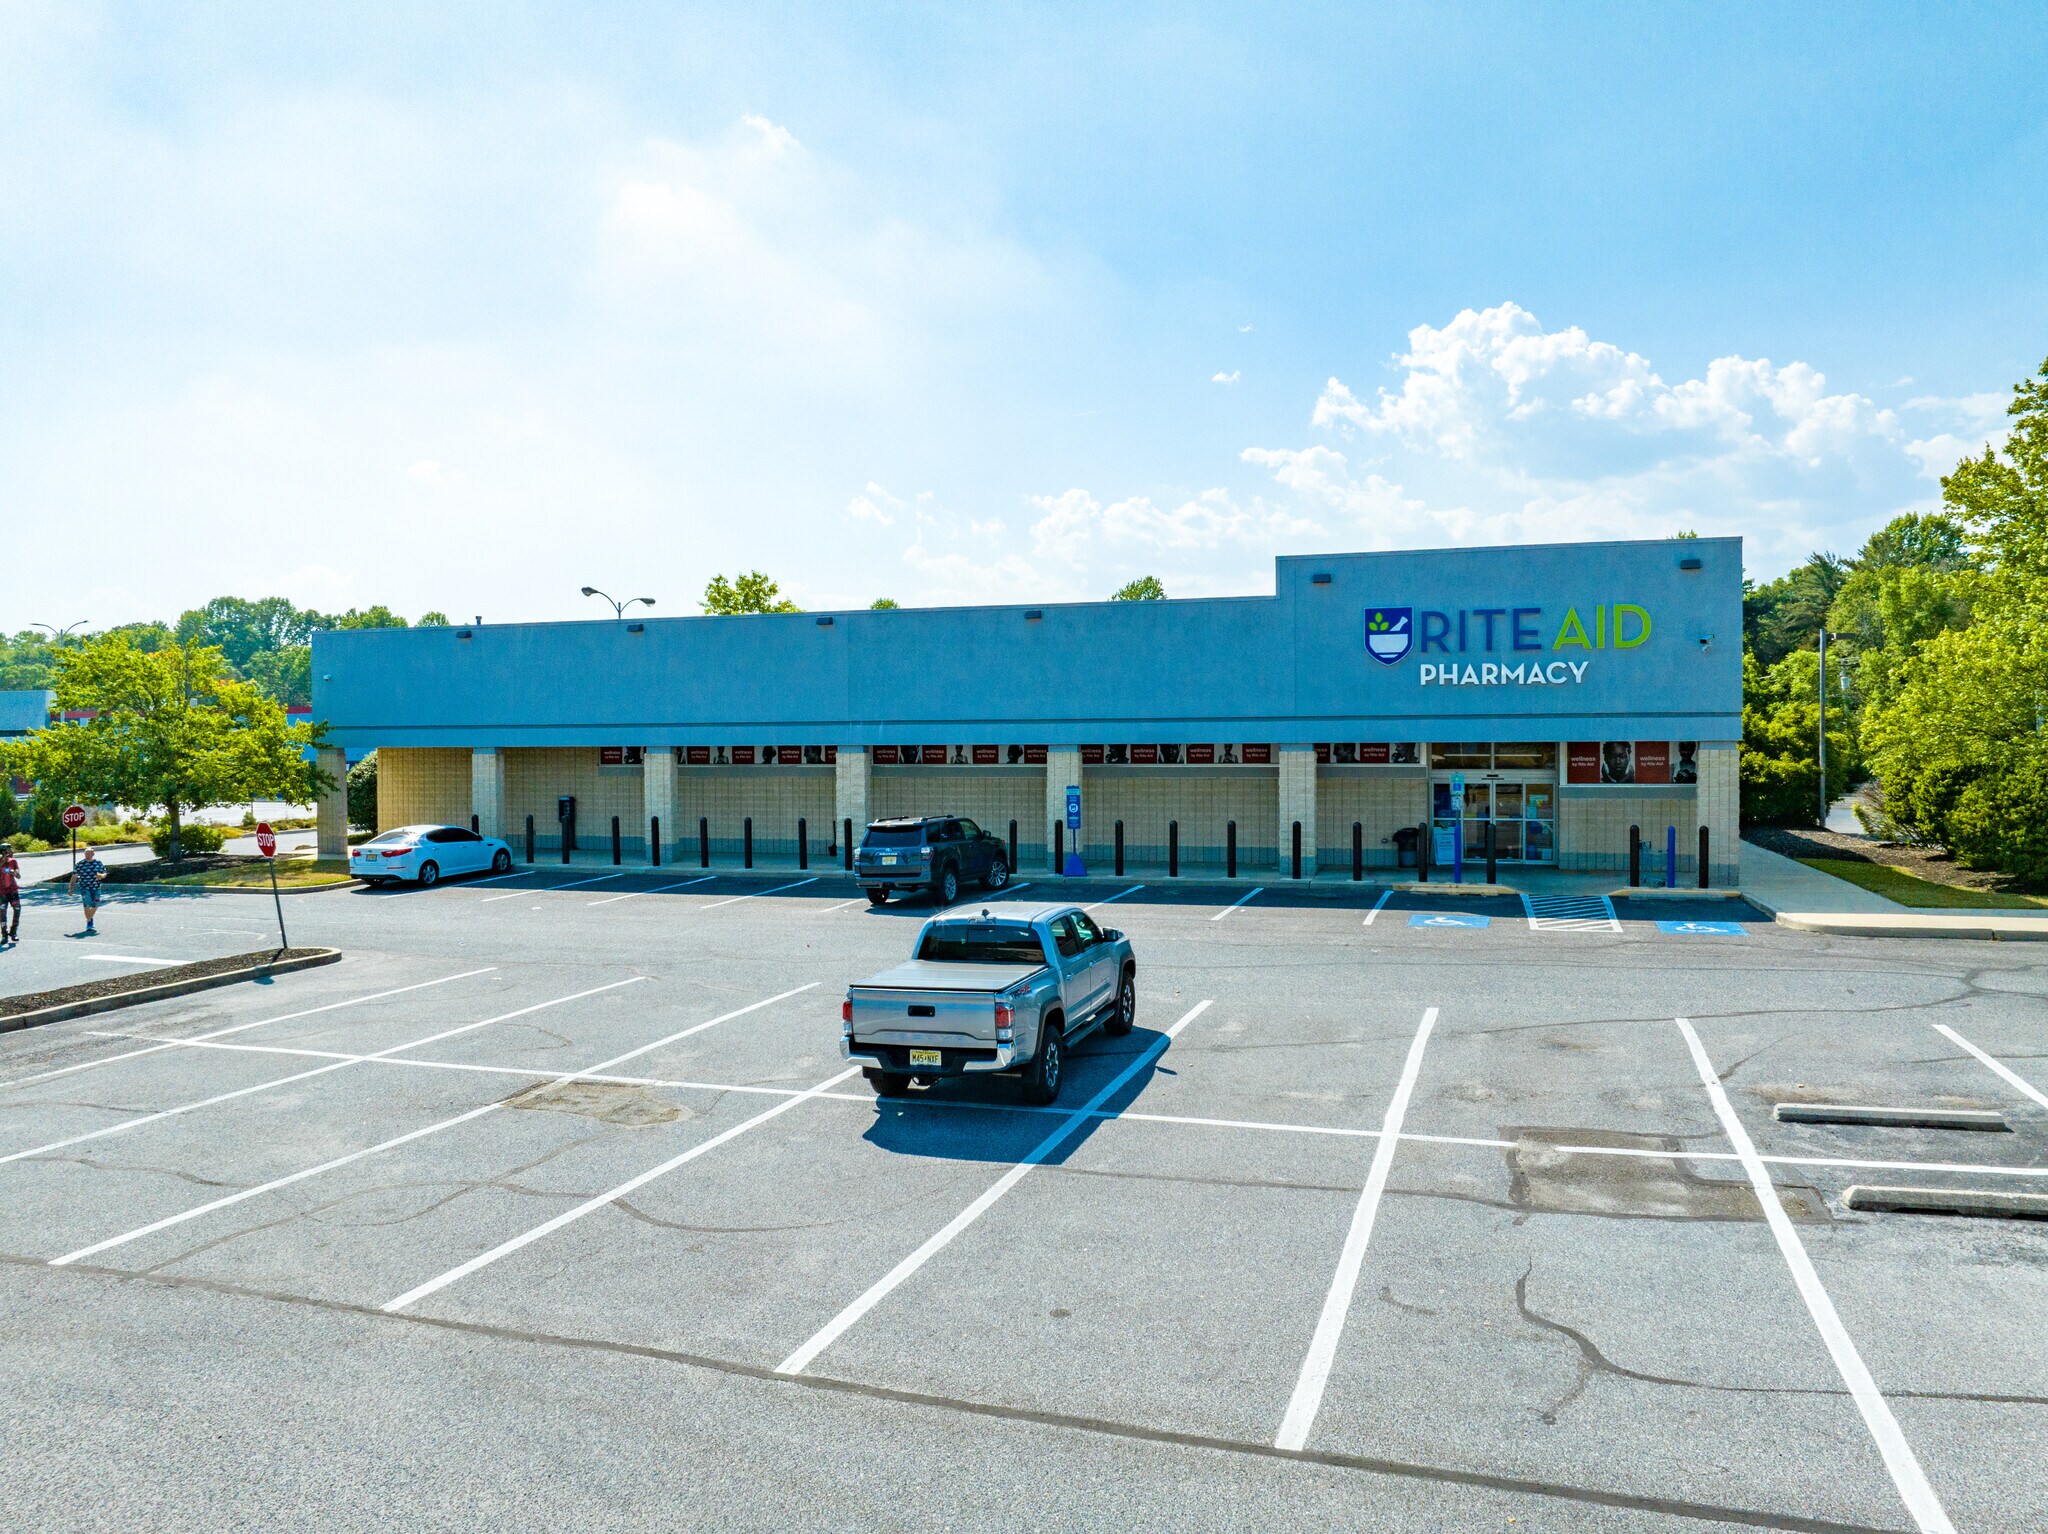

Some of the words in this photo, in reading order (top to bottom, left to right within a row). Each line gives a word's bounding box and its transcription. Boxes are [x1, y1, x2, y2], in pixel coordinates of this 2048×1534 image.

[1421, 607, 1542, 653] RITE
[1552, 604, 1652, 650] AID
[1420, 661, 1590, 686] PHARMACY
[64, 812, 84, 823] STOP
[258, 833, 275, 847] STOP
